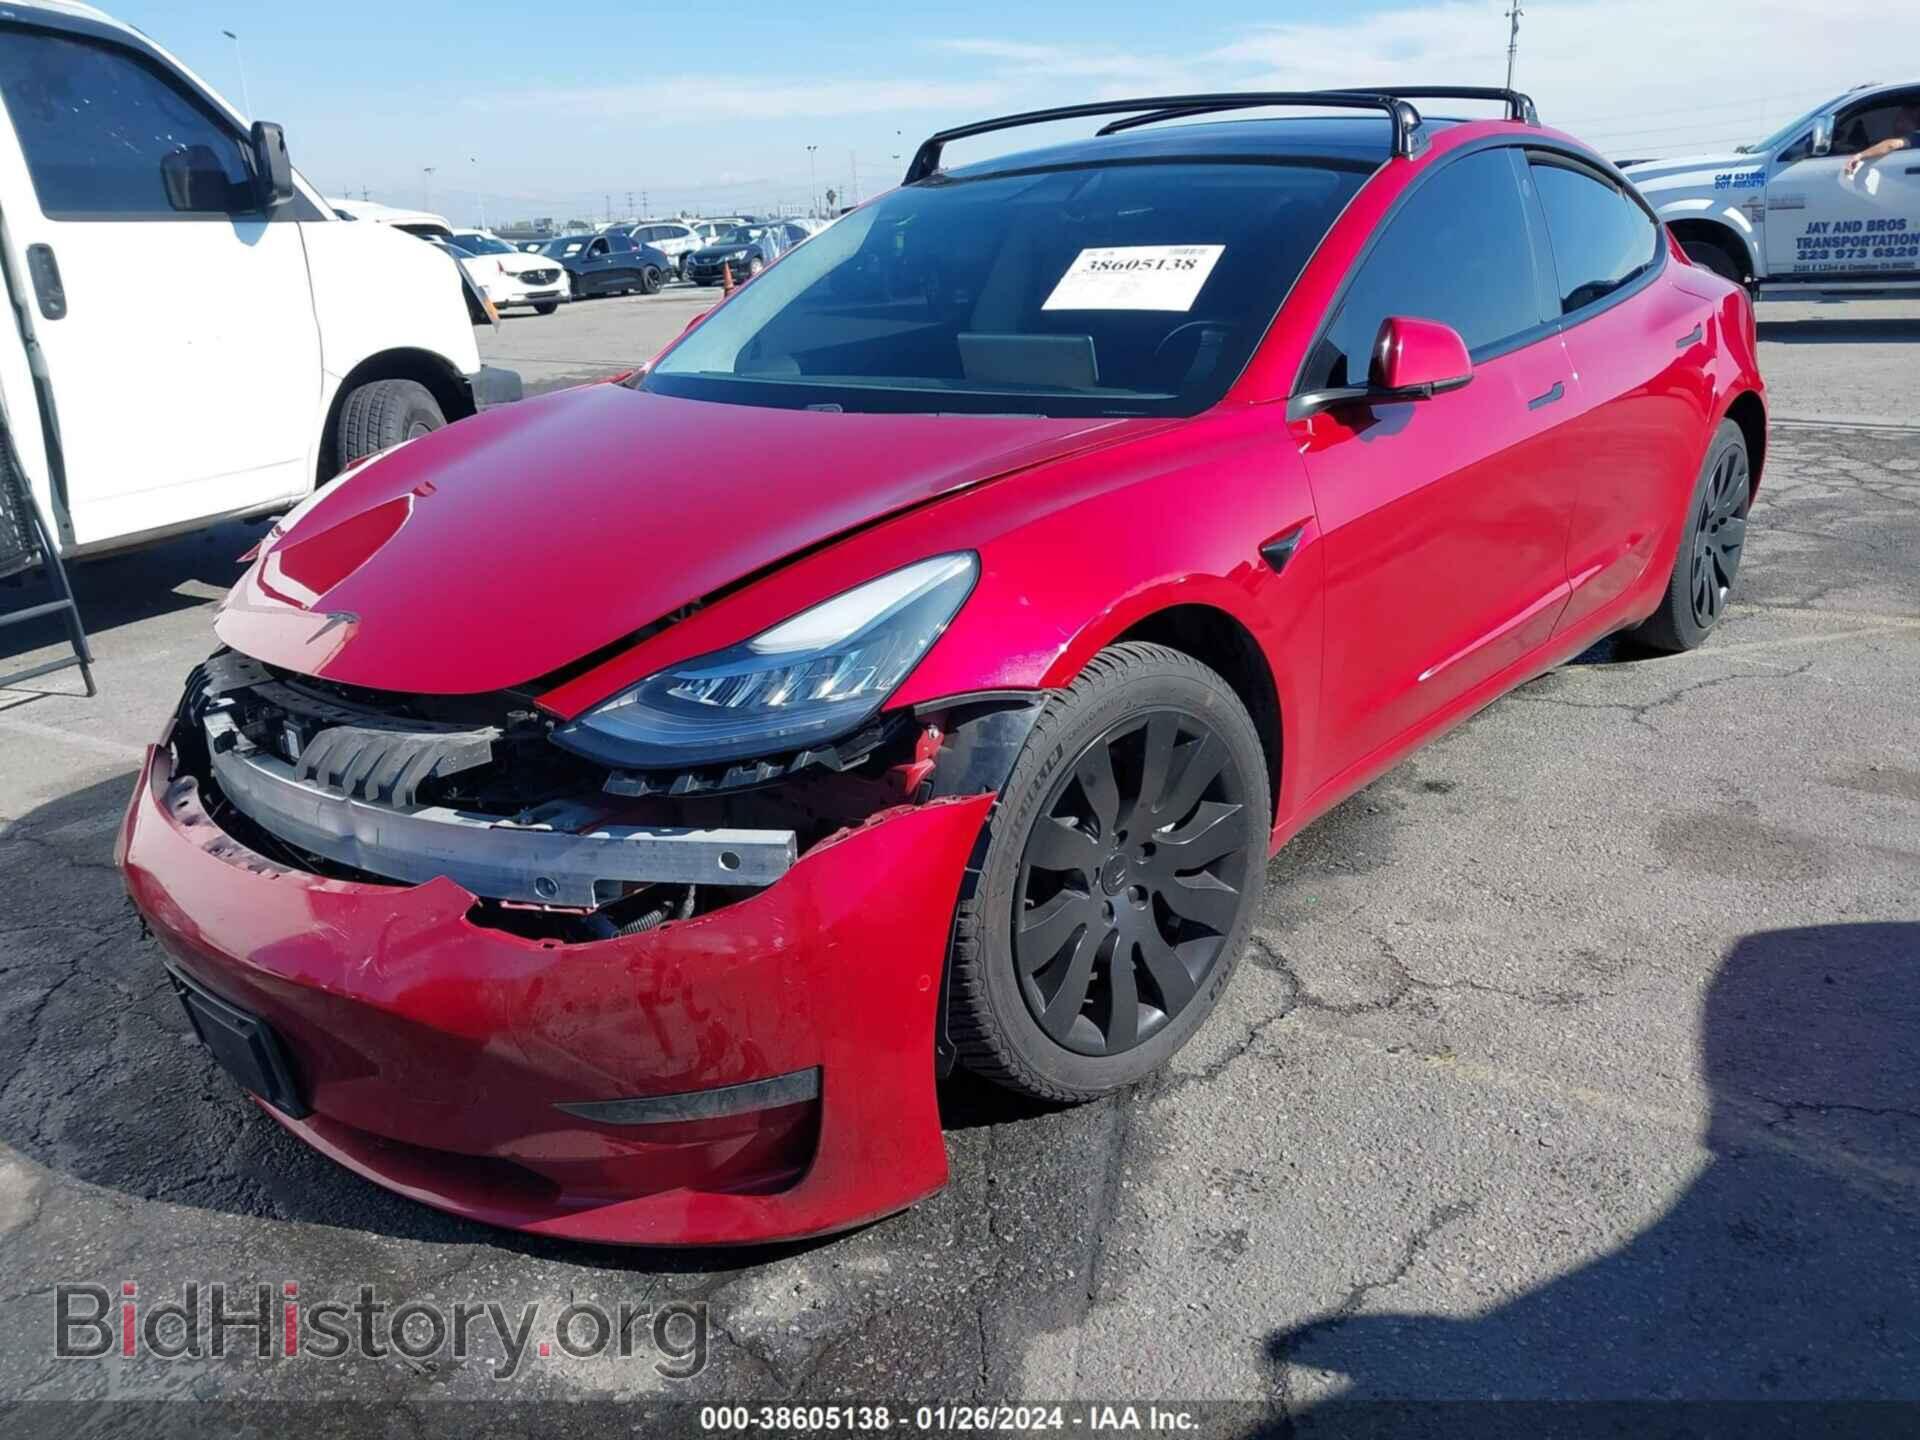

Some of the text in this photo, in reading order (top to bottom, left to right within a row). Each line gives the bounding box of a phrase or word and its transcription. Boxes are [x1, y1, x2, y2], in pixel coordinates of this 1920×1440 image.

[1805, 218, 1907, 235] JAY AND BROS
[1796, 233, 1920, 250] TRANSPORTATION
[1835, 248, 1867, 259] 973
[1083, 257, 1198, 272] 38605138
